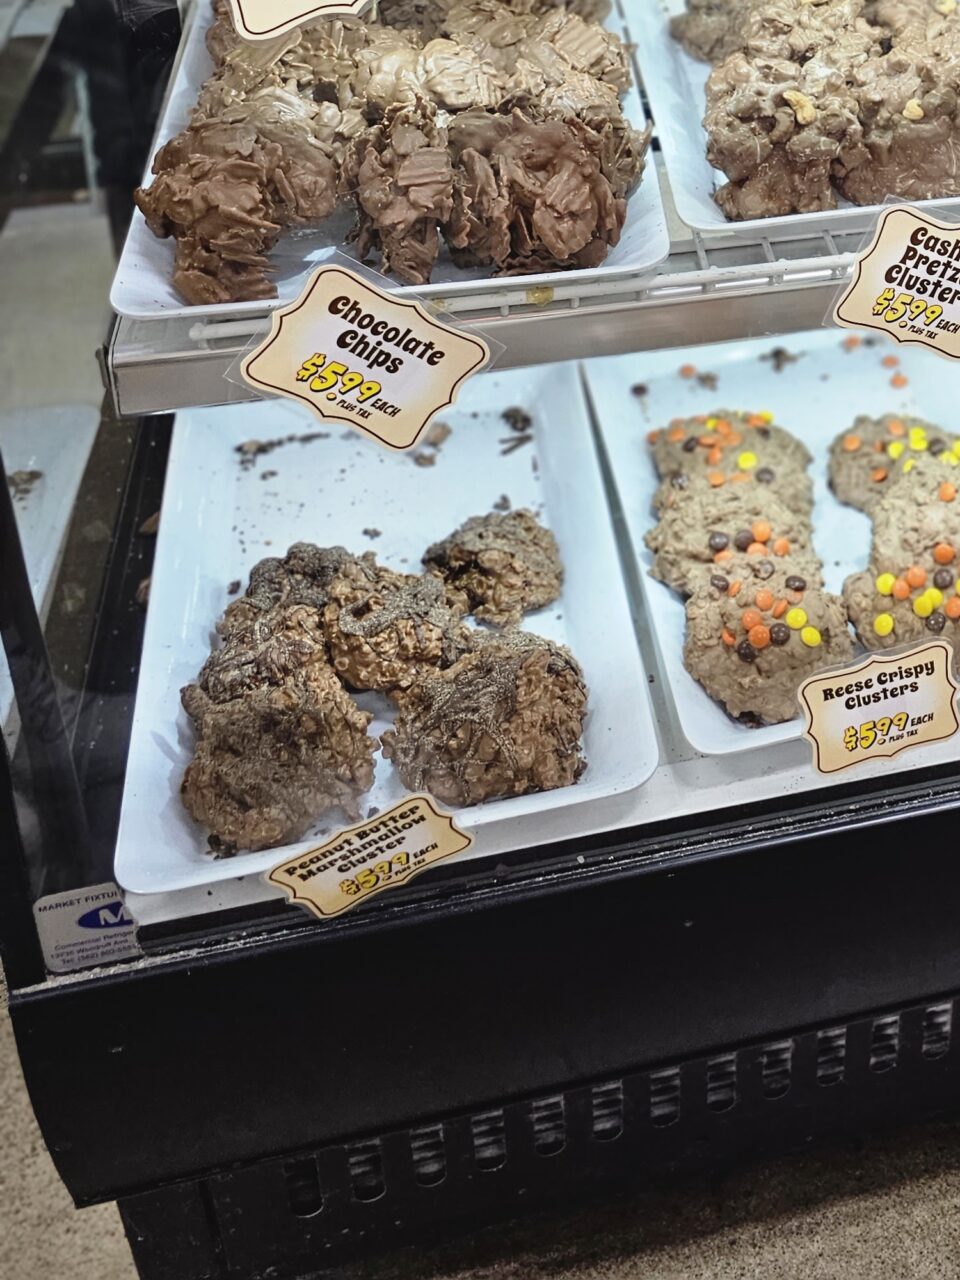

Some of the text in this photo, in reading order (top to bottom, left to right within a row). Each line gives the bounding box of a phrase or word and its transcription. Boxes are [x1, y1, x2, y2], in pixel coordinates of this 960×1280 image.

[872, 288, 944, 328] $5.99
[327, 295, 446, 367] Chocolate
[907, 325, 939, 340] PLUS TAX
[336, 329, 404, 375] Chips
[296, 353, 402, 418] $5.99 EACH
[336, 399, 374, 420] PLUS TAX
[822, 660, 935, 702] Reese Crispy
[844, 681, 919, 710] Clusters
[888, 728, 919, 743] PLUS TAX
[910, 712, 935, 727] EACH
[283, 804, 421, 877] Peanut Butter
[296, 814, 428, 882] Marshmallow
[336, 836, 407, 874] Cluster
[38, 897, 81, 913] MARKET
